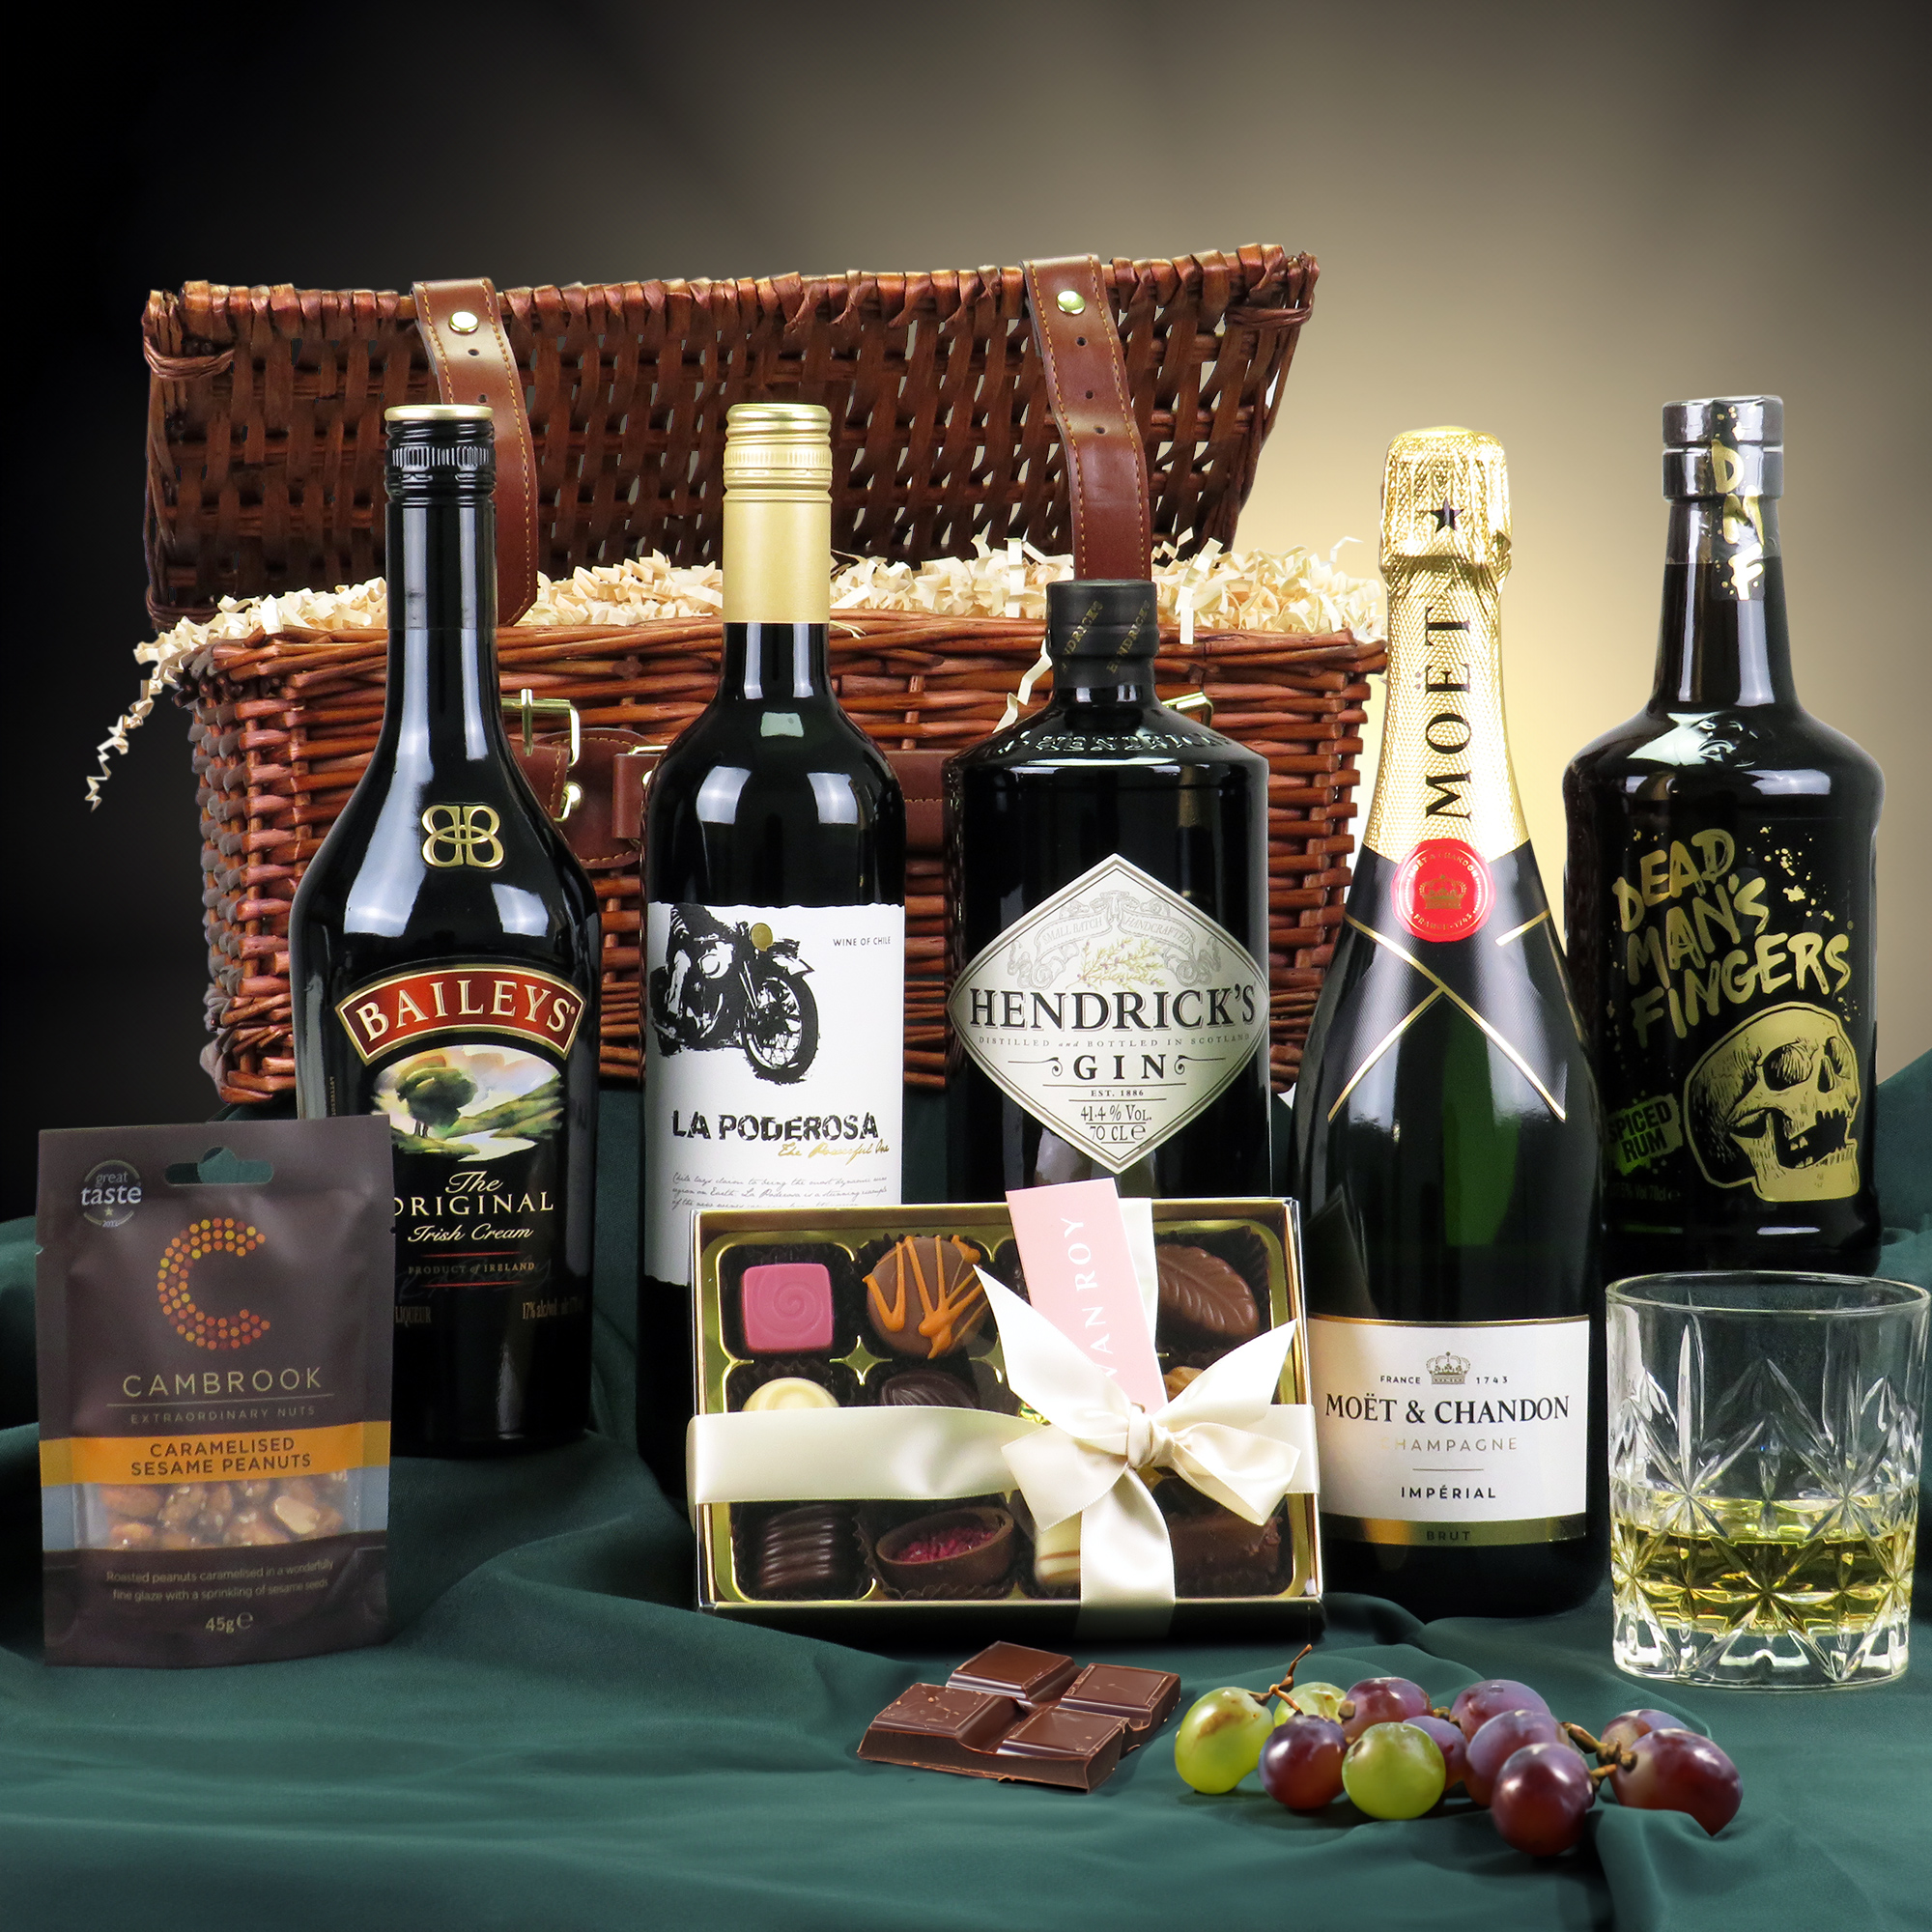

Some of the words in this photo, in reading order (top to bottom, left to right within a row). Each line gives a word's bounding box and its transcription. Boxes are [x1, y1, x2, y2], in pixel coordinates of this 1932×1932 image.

[1416, 606, 1471, 822] MOËT
[1612, 828, 1735, 933] DEAD
[833, 937, 857, 947] WINE
[860, 937, 870, 946] OF
[873, 936, 891, 945] CHILE
[1041, 925, 1070, 945] SMALL
[1073, 917, 1103, 933] BATCH
[1124, 917, 1191, 947] HANDCRAFTED
[1627, 874, 1771, 990] MAN'S
[1631, 932, 1851, 1048] FINGERS
[355, 980, 571, 1042] BAILEYS
[969, 983, 1256, 1032] HENDRICK'S
[979, 1036, 1050, 1047] DISTILLED
[1191, 1034, 1250, 1045] SCOTLAND
[1072, 1053, 1167, 1080] GIN
[1121, 1089, 1144, 1097] 1886
[671, 1109, 712, 1140] LA
[718, 1111, 880, 1142] PODEROSA
[1090, 1125, 1106, 1141] 70
[1111, 1125, 1128, 1141] CL
[1606, 1100, 1673, 1142] SPICED
[778, 1142, 803, 1157] The
[809, 1141, 872, 1166] Powerful
[875, 1139, 890, 1154] One
[1621, 1126, 1668, 1164] RUM
[96, 1171, 128, 1188] great
[444, 1170, 503, 1193] The
[80, 1185, 142, 1207] taste
[407, 1224, 466, 1242] Irish
[470, 1223, 534, 1240] Cream
[1060, 1217, 1098, 1292] ROY
[408, 1265, 467, 1275] PRODUCT
[469, 1264, 481, 1275] of
[483, 1262, 535, 1273] IRELAND
[123, 1366, 322, 1398] CAMBROOK
[1379, 1375, 1421, 1384] FRANCE
[1476, 1376, 1509, 1385] 1743
[130, 1407, 269, 1425] EXTRAORDINARY
[277, 1406, 316, 1418] NUTS
[1325, 1392, 1398, 1423] MOËT
[1405, 1399, 1426, 1424] &
[1434, 1395, 1570, 1425] CHANDON
[150, 1436, 295, 1459] CARAMELISED
[130, 1458, 213, 1477] SESAME
[222, 1453, 312, 1473] PEANUTS
[1401, 1484, 1496, 1499] IMPÉRIAL
[1426, 1530, 1471, 1542] BRUT
[106, 1570, 150, 1583] Roasted
[152, 1570, 197, 1585] peanuts
[199, 1567, 264, 1581] caramelised
[266, 1565, 276, 1577] in
[285, 1558, 334, 1575] wonderfully
[112, 1588, 132, 1601] fine
[134, 1590, 163, 1604] glaze
[165, 1588, 190, 1602] with
[191, 1591, 199, 1601] a
[200, 1585, 253, 1603] sprinkling
[255, 1584, 267, 1597] of
[268, 1584, 304, 1596] sesame
[305, 1577, 328, 1591] seeds
[205, 1615, 235, 1634] 45g
